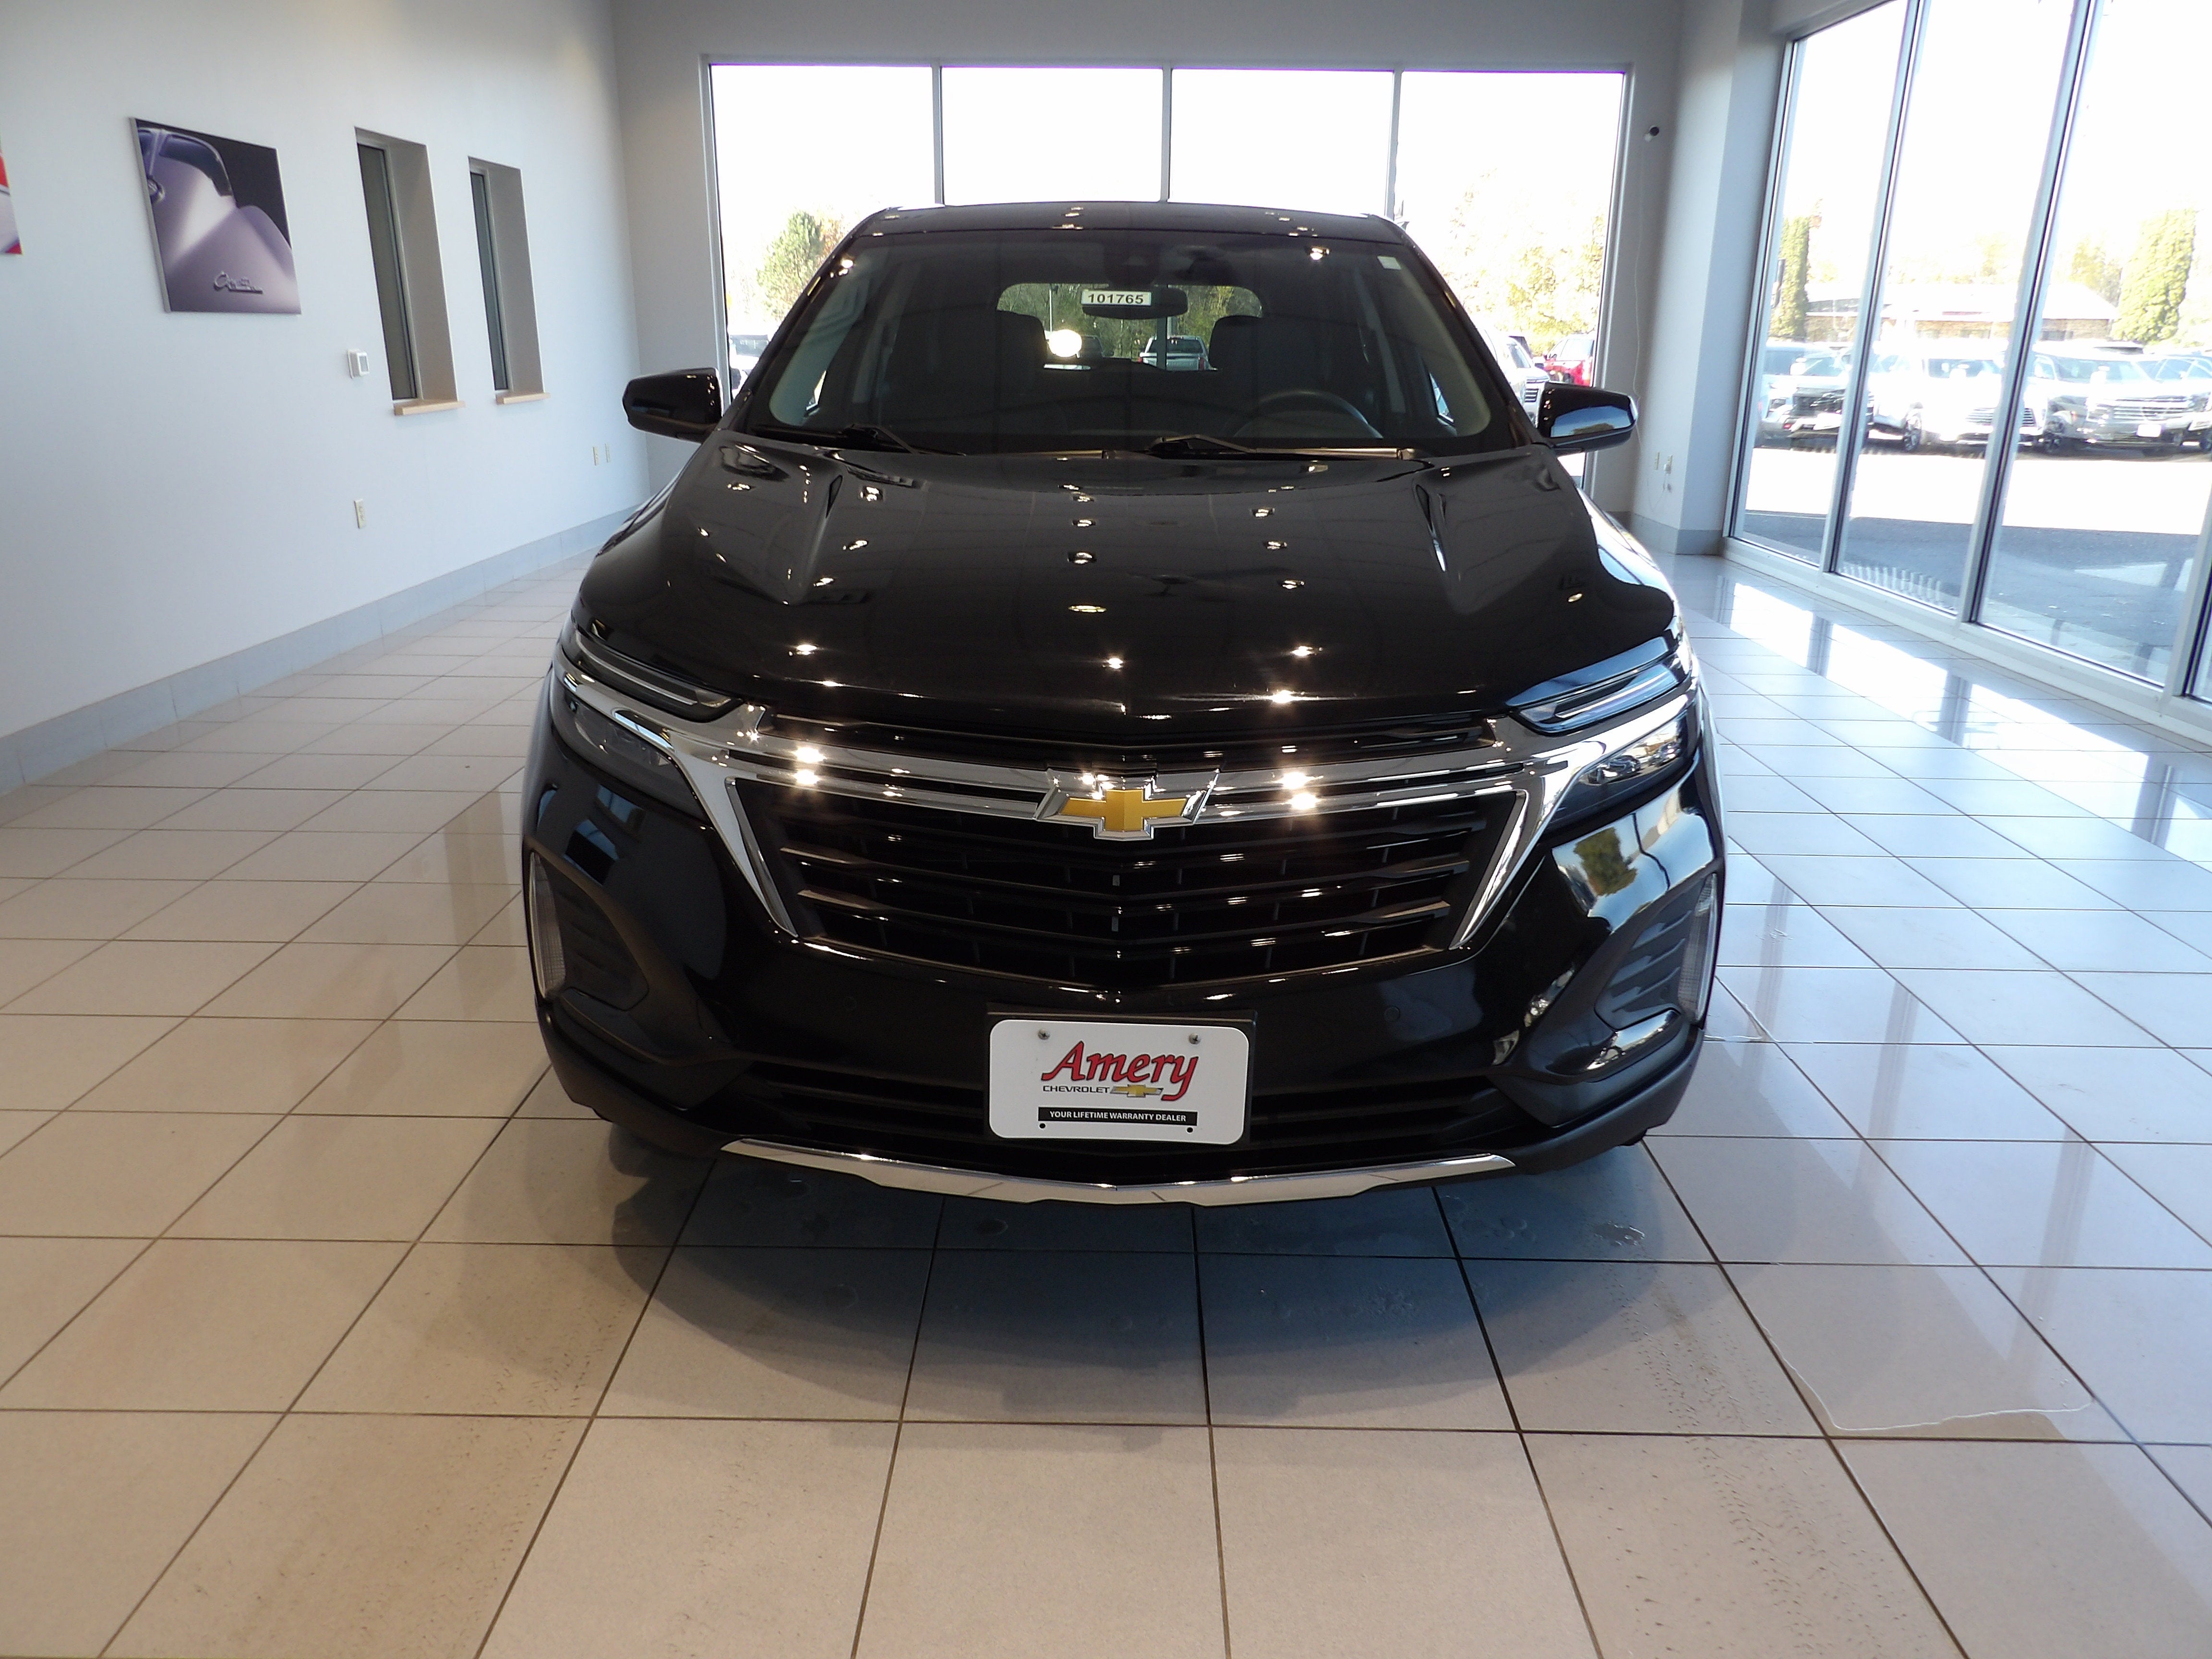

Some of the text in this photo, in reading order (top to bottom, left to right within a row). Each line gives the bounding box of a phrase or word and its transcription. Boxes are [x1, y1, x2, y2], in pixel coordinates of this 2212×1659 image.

[1088, 293, 1144, 304] 101765
[1041, 1040, 1199, 1101] Amery
[1043, 1085, 1110, 1094] CHEVROLET
[1109, 1112, 1154, 1120] WARRANTY
[1155, 1113, 1186, 1122] DEALER
